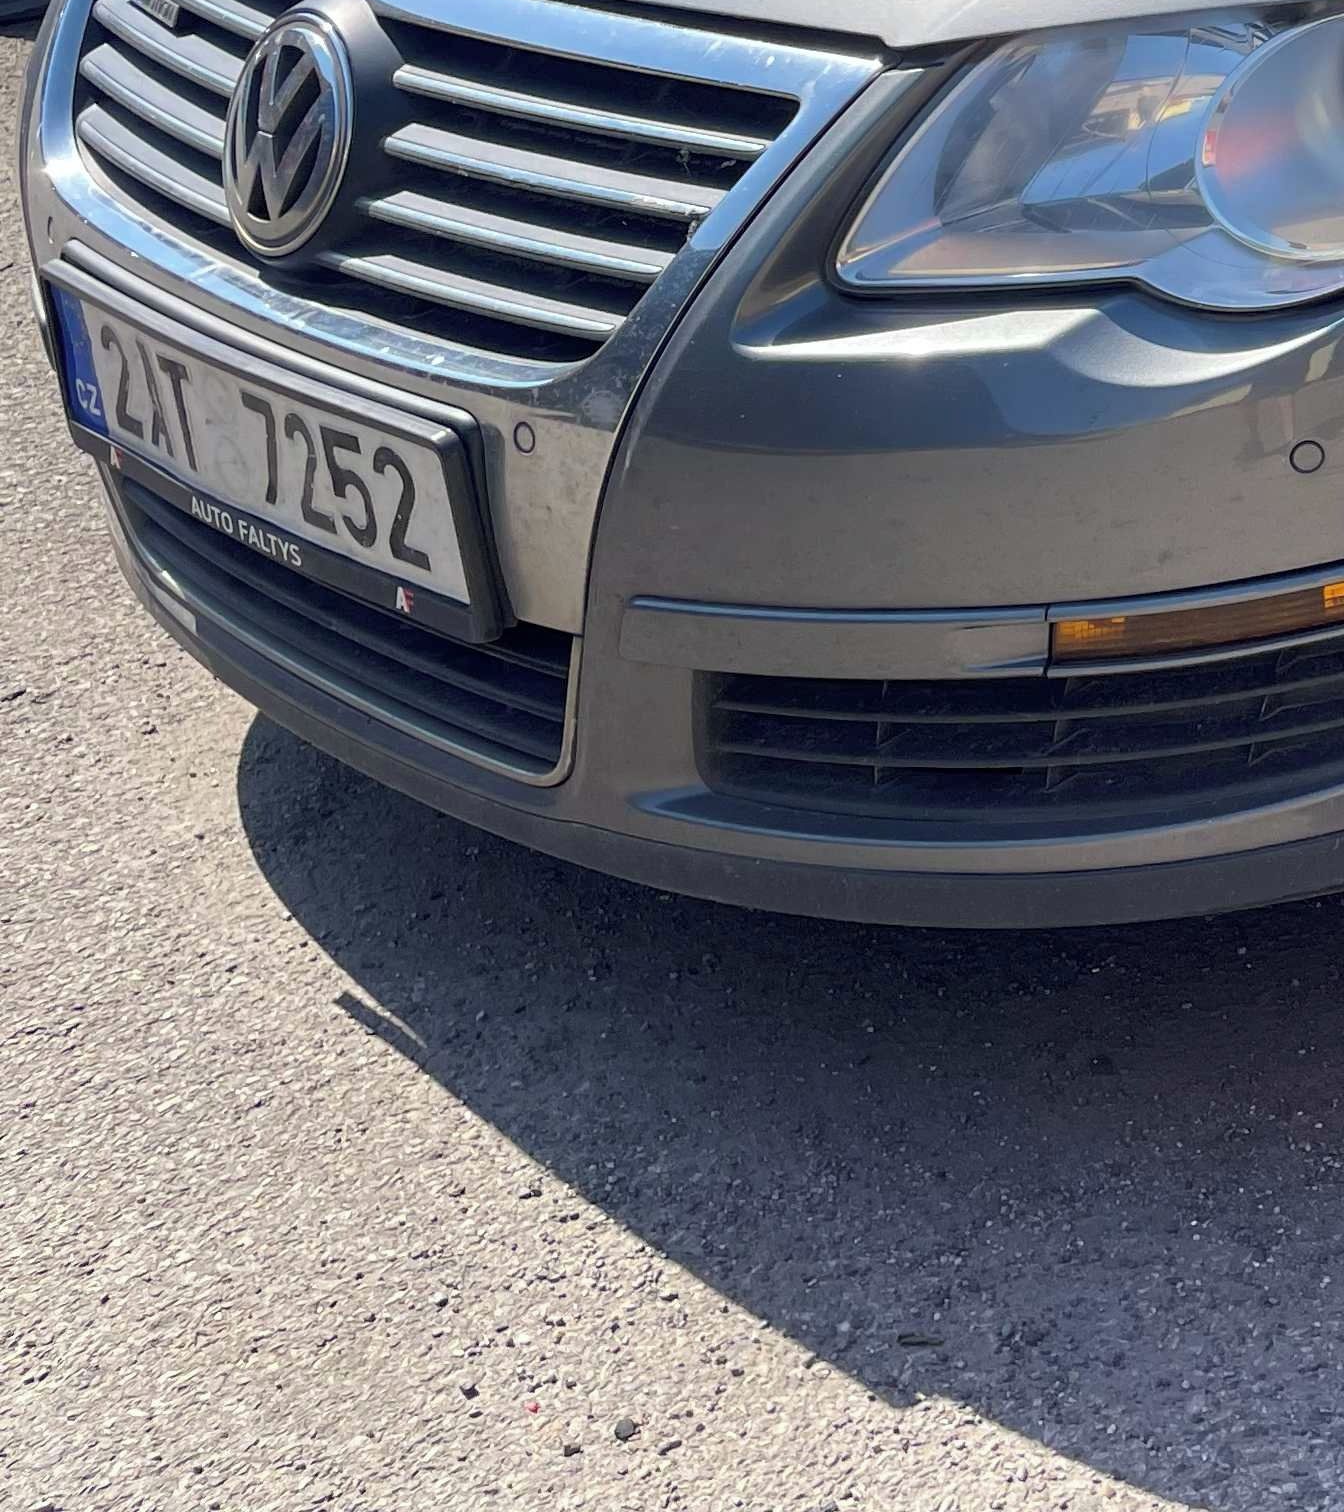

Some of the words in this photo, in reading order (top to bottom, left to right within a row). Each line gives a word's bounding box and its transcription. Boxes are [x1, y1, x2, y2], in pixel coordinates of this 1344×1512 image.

[76, 378, 101, 416] CZ
[240, 390, 432, 571] 7252
[191, 495, 234, 534] AUTO
[238, 519, 302, 567] FALTYS
